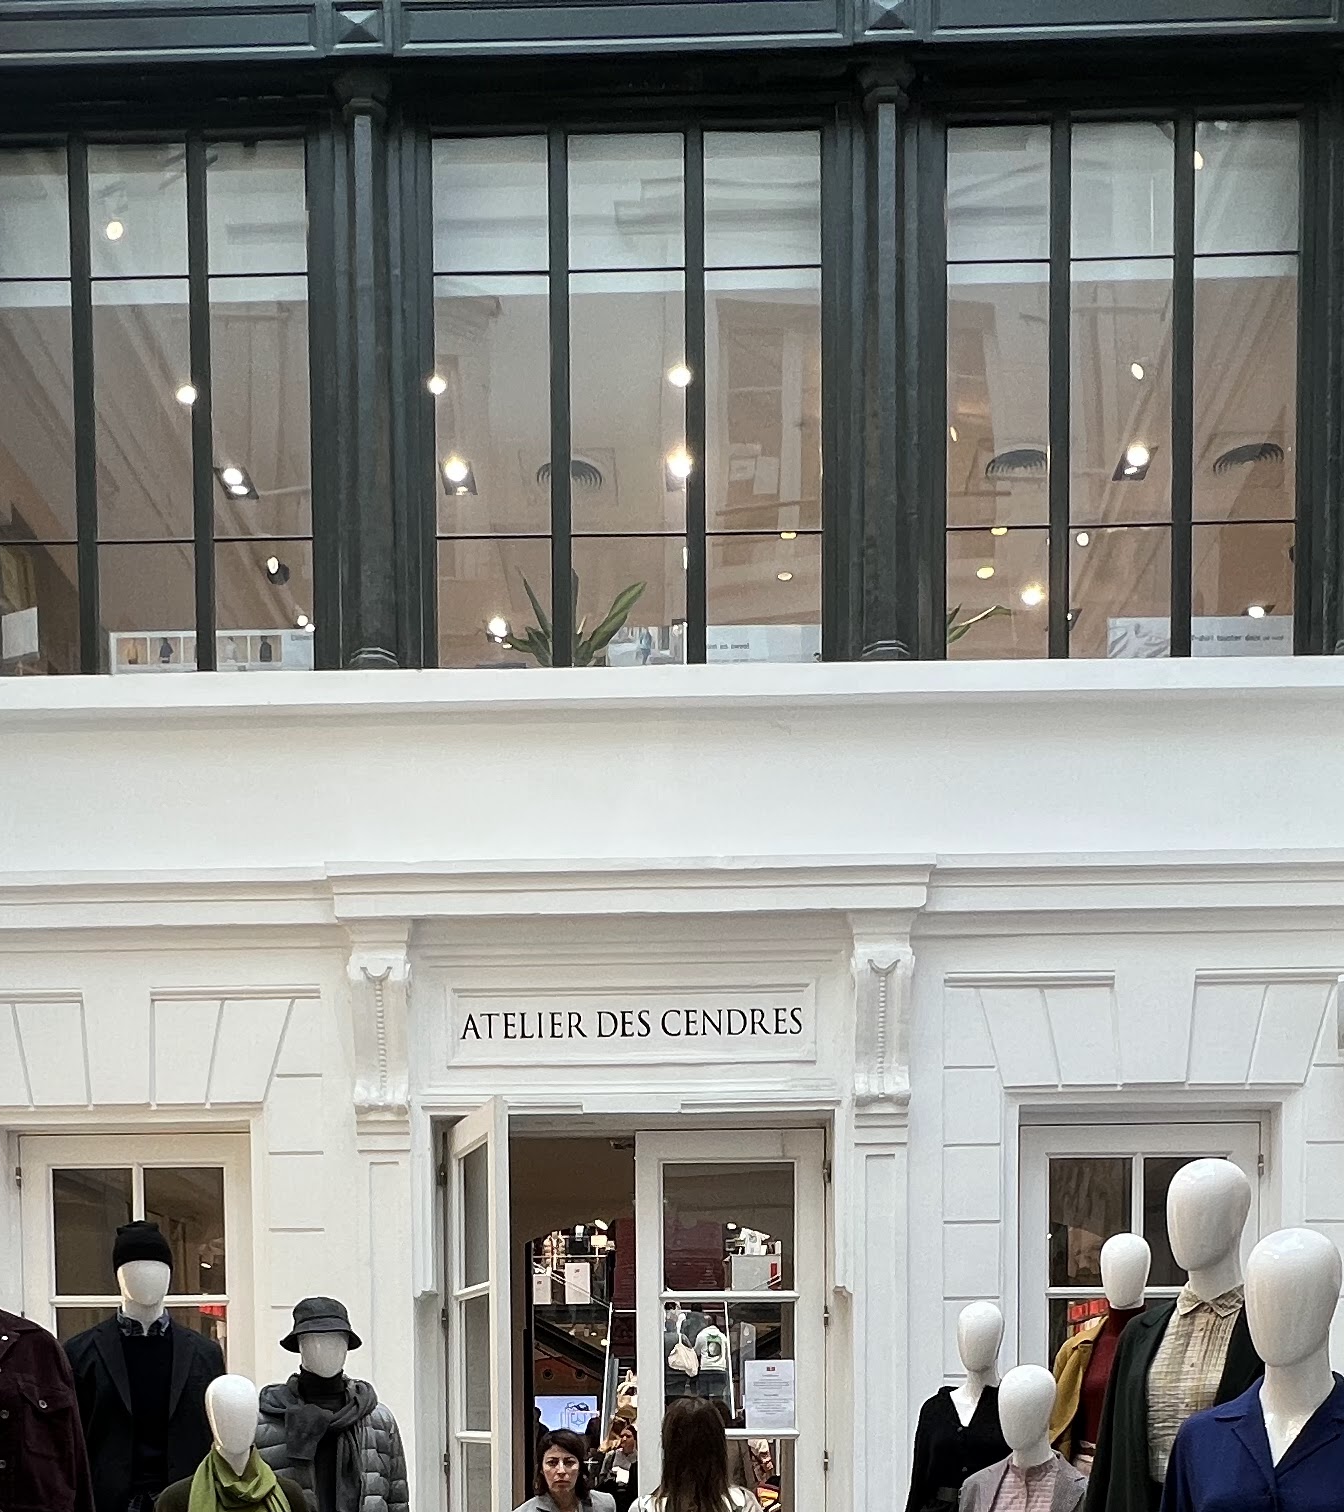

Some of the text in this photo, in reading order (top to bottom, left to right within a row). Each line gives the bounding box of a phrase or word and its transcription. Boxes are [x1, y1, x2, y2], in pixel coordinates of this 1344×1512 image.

[460, 1006, 803, 1041] ATELIER DES CENDRES
